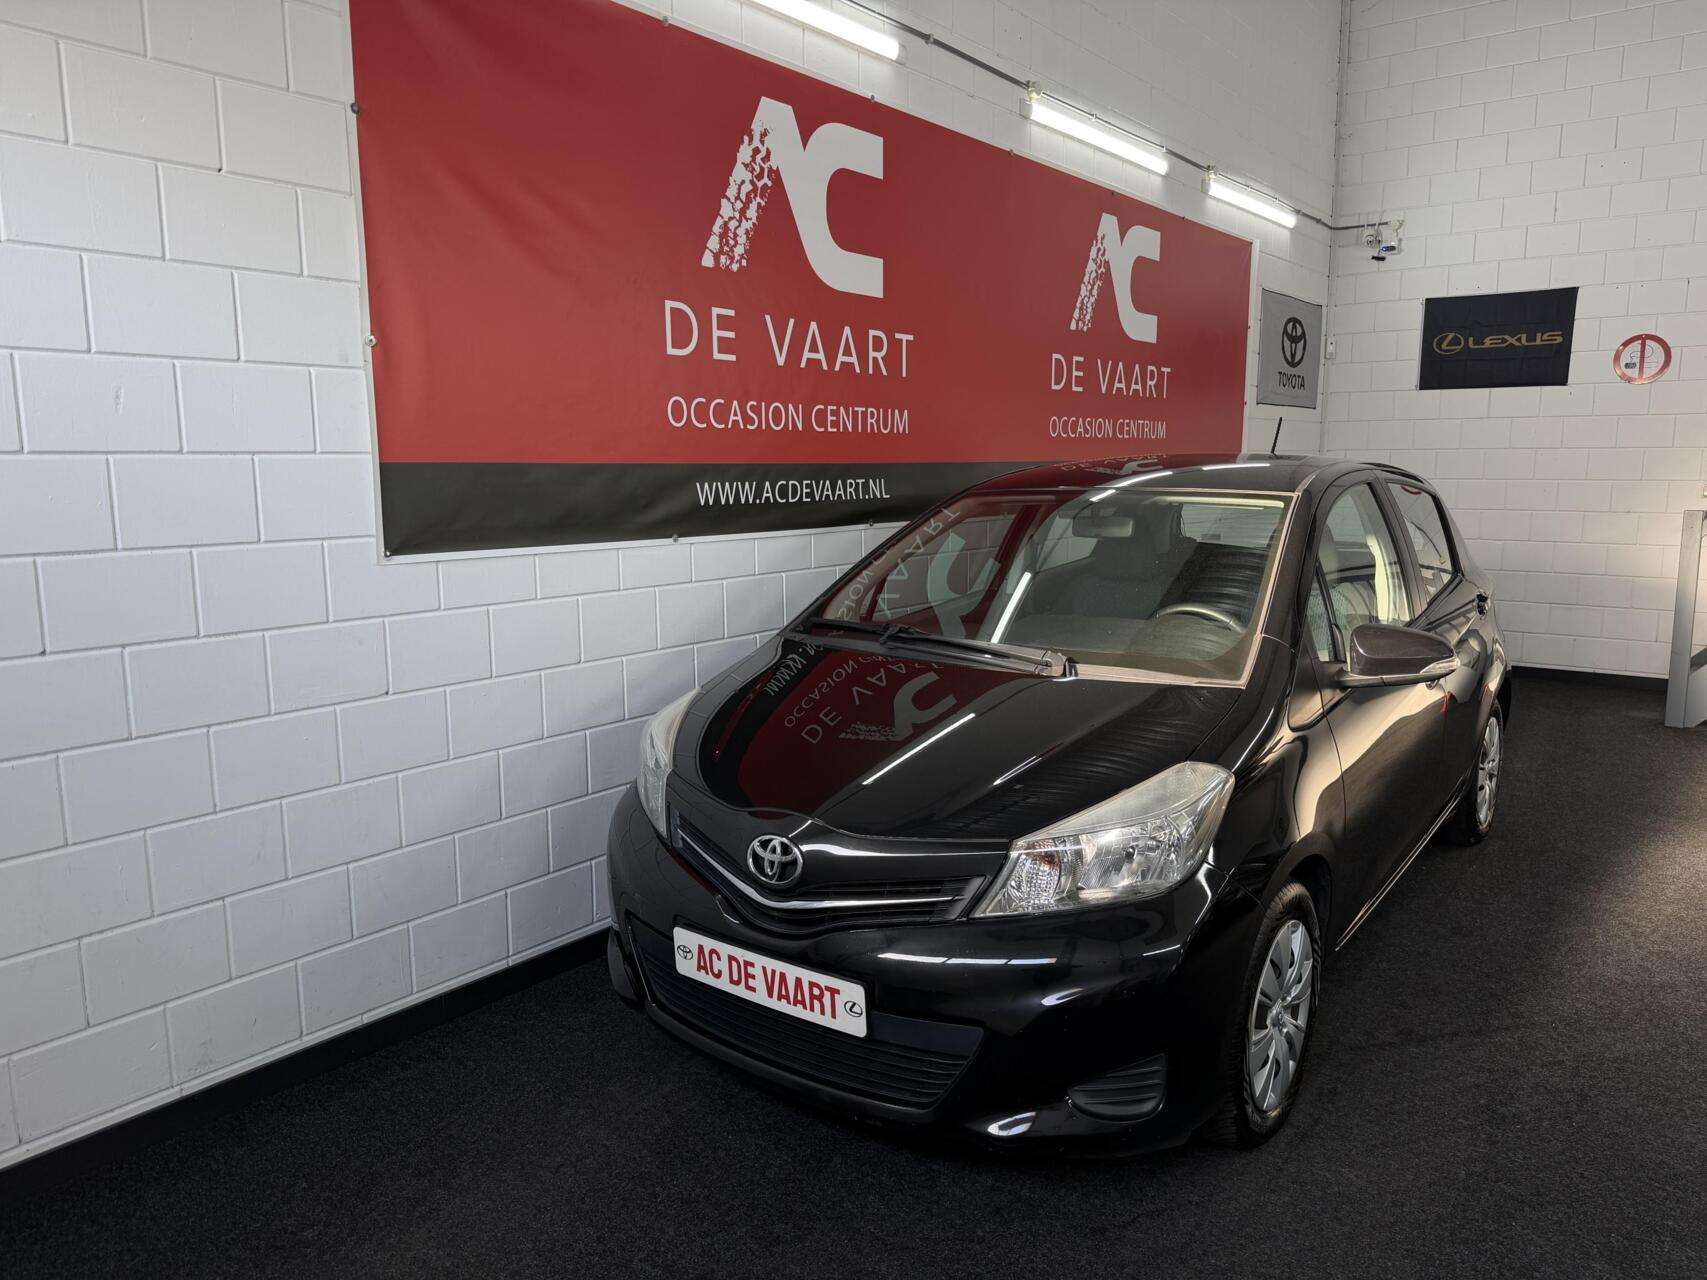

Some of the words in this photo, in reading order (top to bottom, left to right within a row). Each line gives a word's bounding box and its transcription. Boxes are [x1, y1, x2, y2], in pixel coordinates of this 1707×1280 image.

[664, 299, 737, 363] DE
[764, 314, 914, 378] VAART
[1468, 331, 1564, 349] LEXUS
[1051, 353, 1084, 392] DE
[1097, 358, 1171, 399] VAART
[1278, 371, 1305, 390] TOYOTA
[667, 396, 803, 432] OCCASION
[811, 404, 909, 435] CENTRUM
[1049, 416, 1113, 439] OCCASION
[1116, 419, 1166, 440] CENTRUM
[696, 478, 890, 507] WWW.ACDEVAART.NL
[696, 943, 723, 980] AC
[727, 954, 757, 993] DE
[762, 965, 841, 1020] VAART
